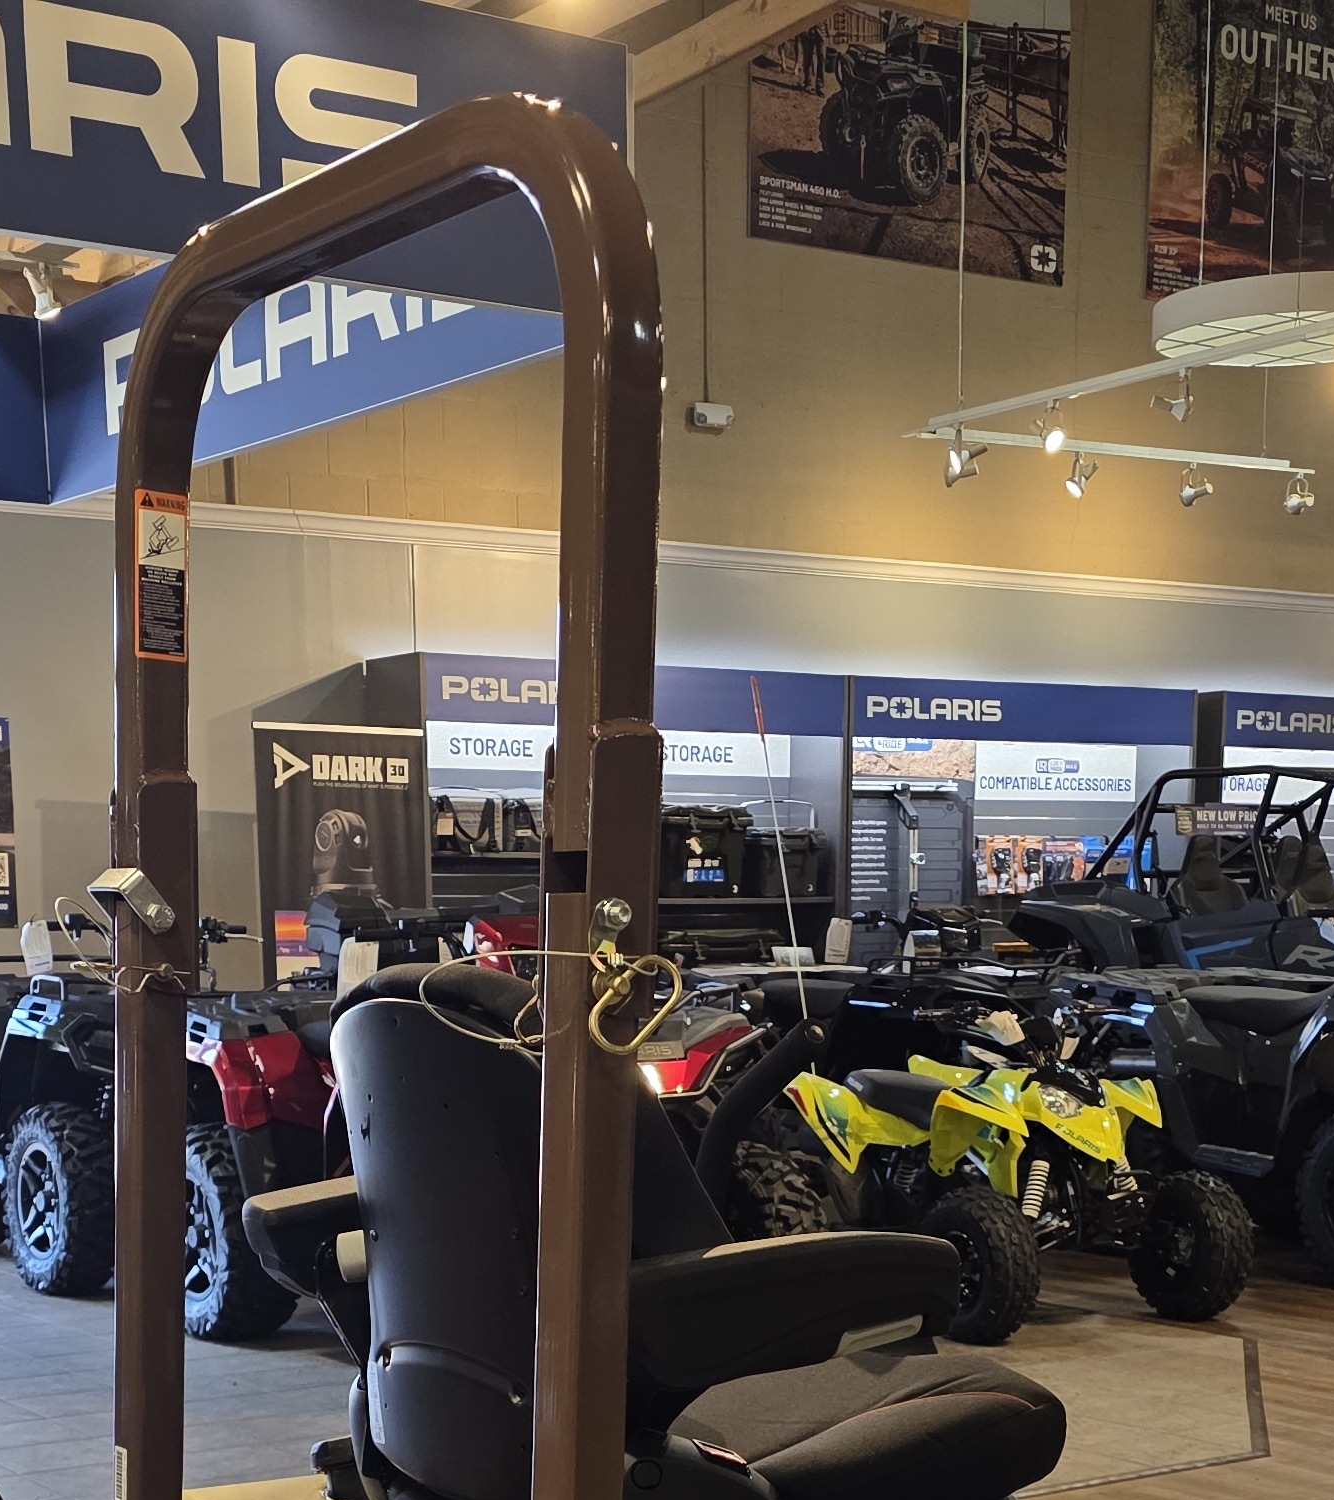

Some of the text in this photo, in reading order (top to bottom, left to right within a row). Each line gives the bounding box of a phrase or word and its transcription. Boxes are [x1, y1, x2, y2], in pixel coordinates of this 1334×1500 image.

[1265, 3, 1317, 31] MEET US
[1220, 23, 1278, 68] OUT
[759, 175, 808, 193] SPORTSMAN
[809, 184, 825, 197] 450
[155, 496, 186, 511] WARNING
[441, 675, 556, 705] POLA
[866, 695, 1002, 722] POLARIS
[449, 736, 534, 758] STORAGE
[312, 754, 405, 783] DARK 30
[979, 775, 1132, 792] COMPATIBLE ACCESSORIES
[1223, 774, 1268, 792] TORAGE
[1196, 810, 1216, 822] NEW
[1217, 810, 1237, 822] LOW
[1238, 810, 1258, 822] PRIC
[638, 1045, 672, 1057] ARIS
[1055, 1123, 1101, 1154] POLARIS
